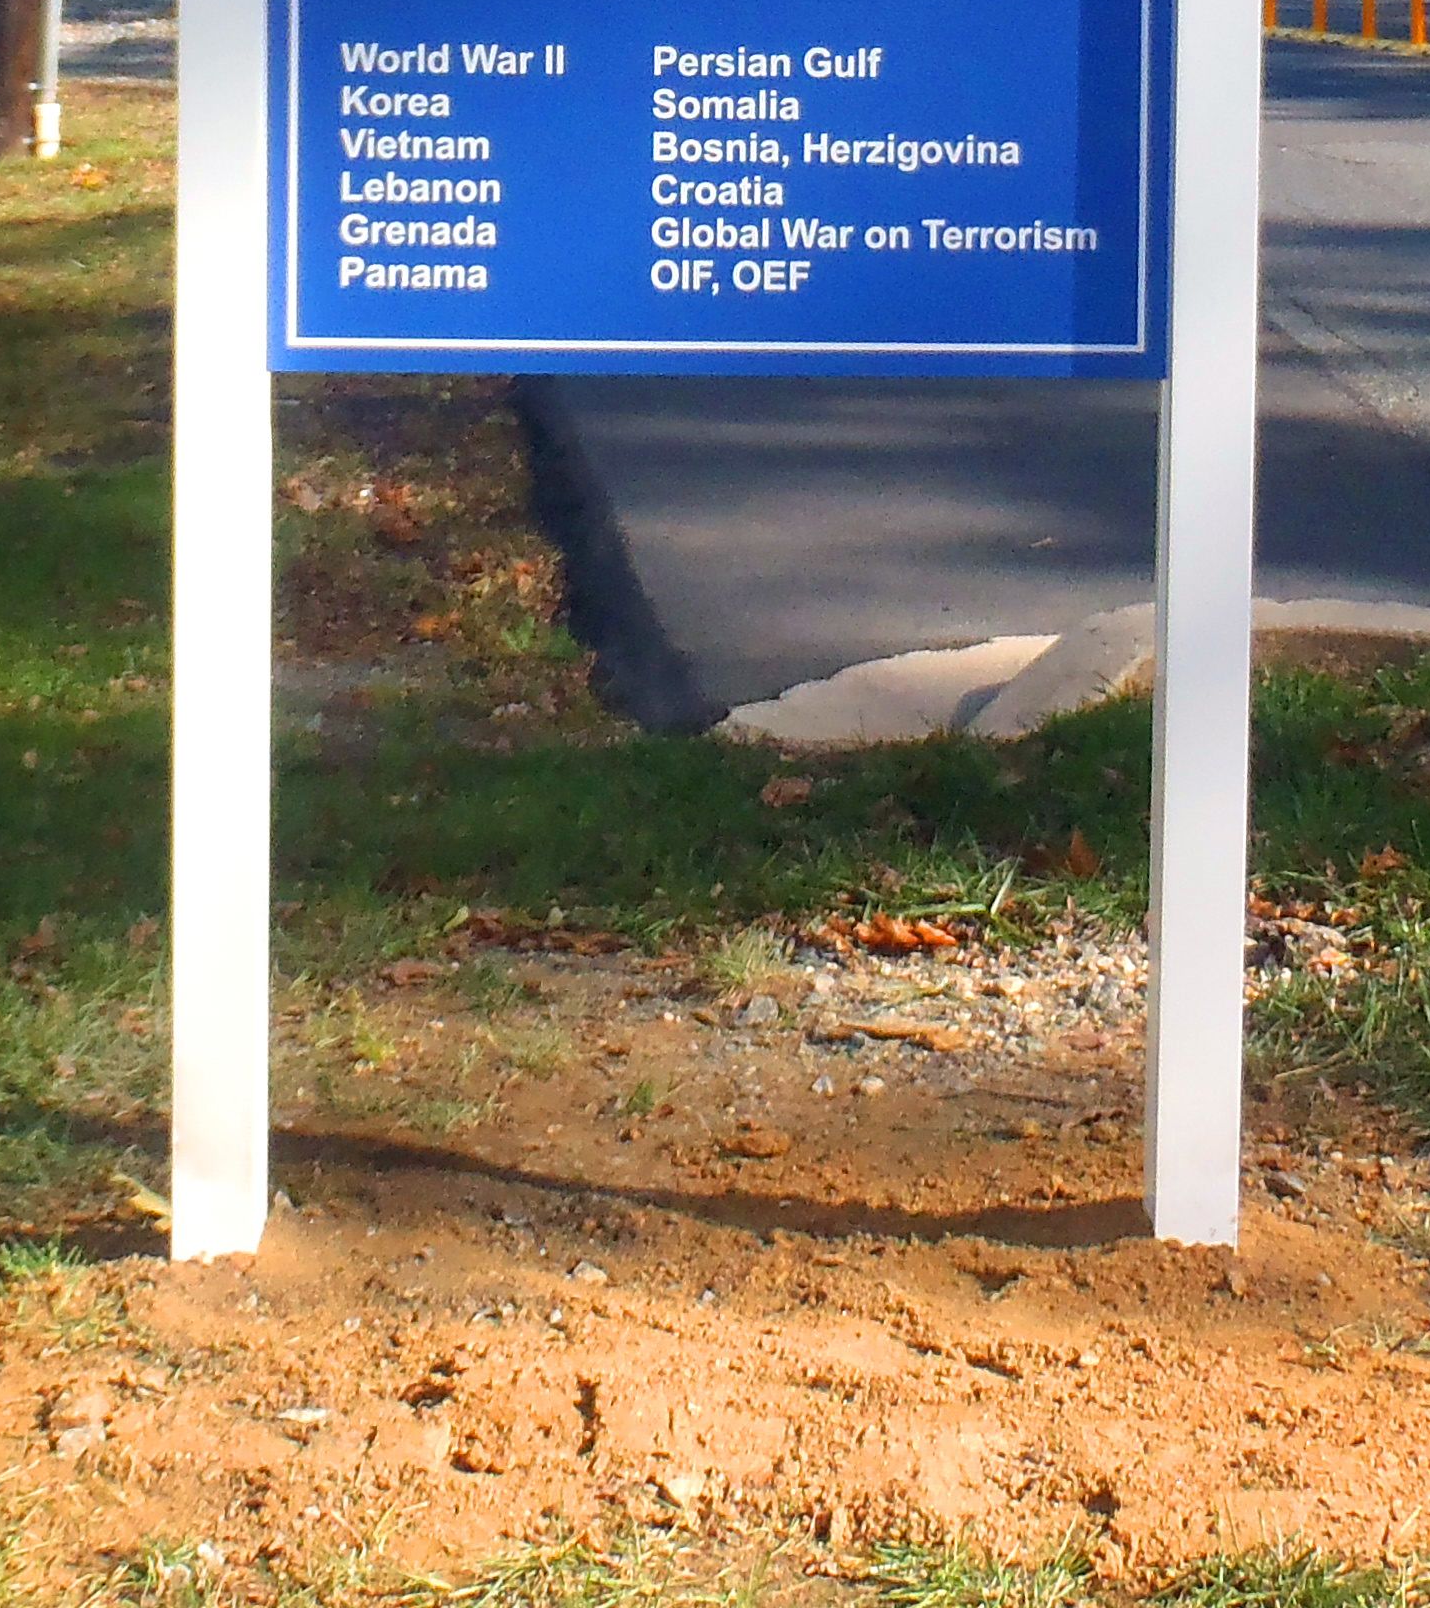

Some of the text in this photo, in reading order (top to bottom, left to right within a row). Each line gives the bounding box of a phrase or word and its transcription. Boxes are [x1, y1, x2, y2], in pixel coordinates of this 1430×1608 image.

[339, 41, 569, 78] World War II
[653, 43, 884, 80] Persian Gulf
[339, 84, 452, 119] Korea
[652, 87, 802, 122] Somalia
[338, 127, 492, 162] Vietnam
[652, 130, 1023, 172] Bosnia, Herzigovina
[338, 170, 503, 205] Lebanon
[651, 173, 785, 209] Croatia
[337, 212, 499, 249] Grenada
[650, 216, 1098, 253] Global War on Terrorism
[338, 255, 491, 292] Panama
[650, 258, 812, 297] OIF, OEF
